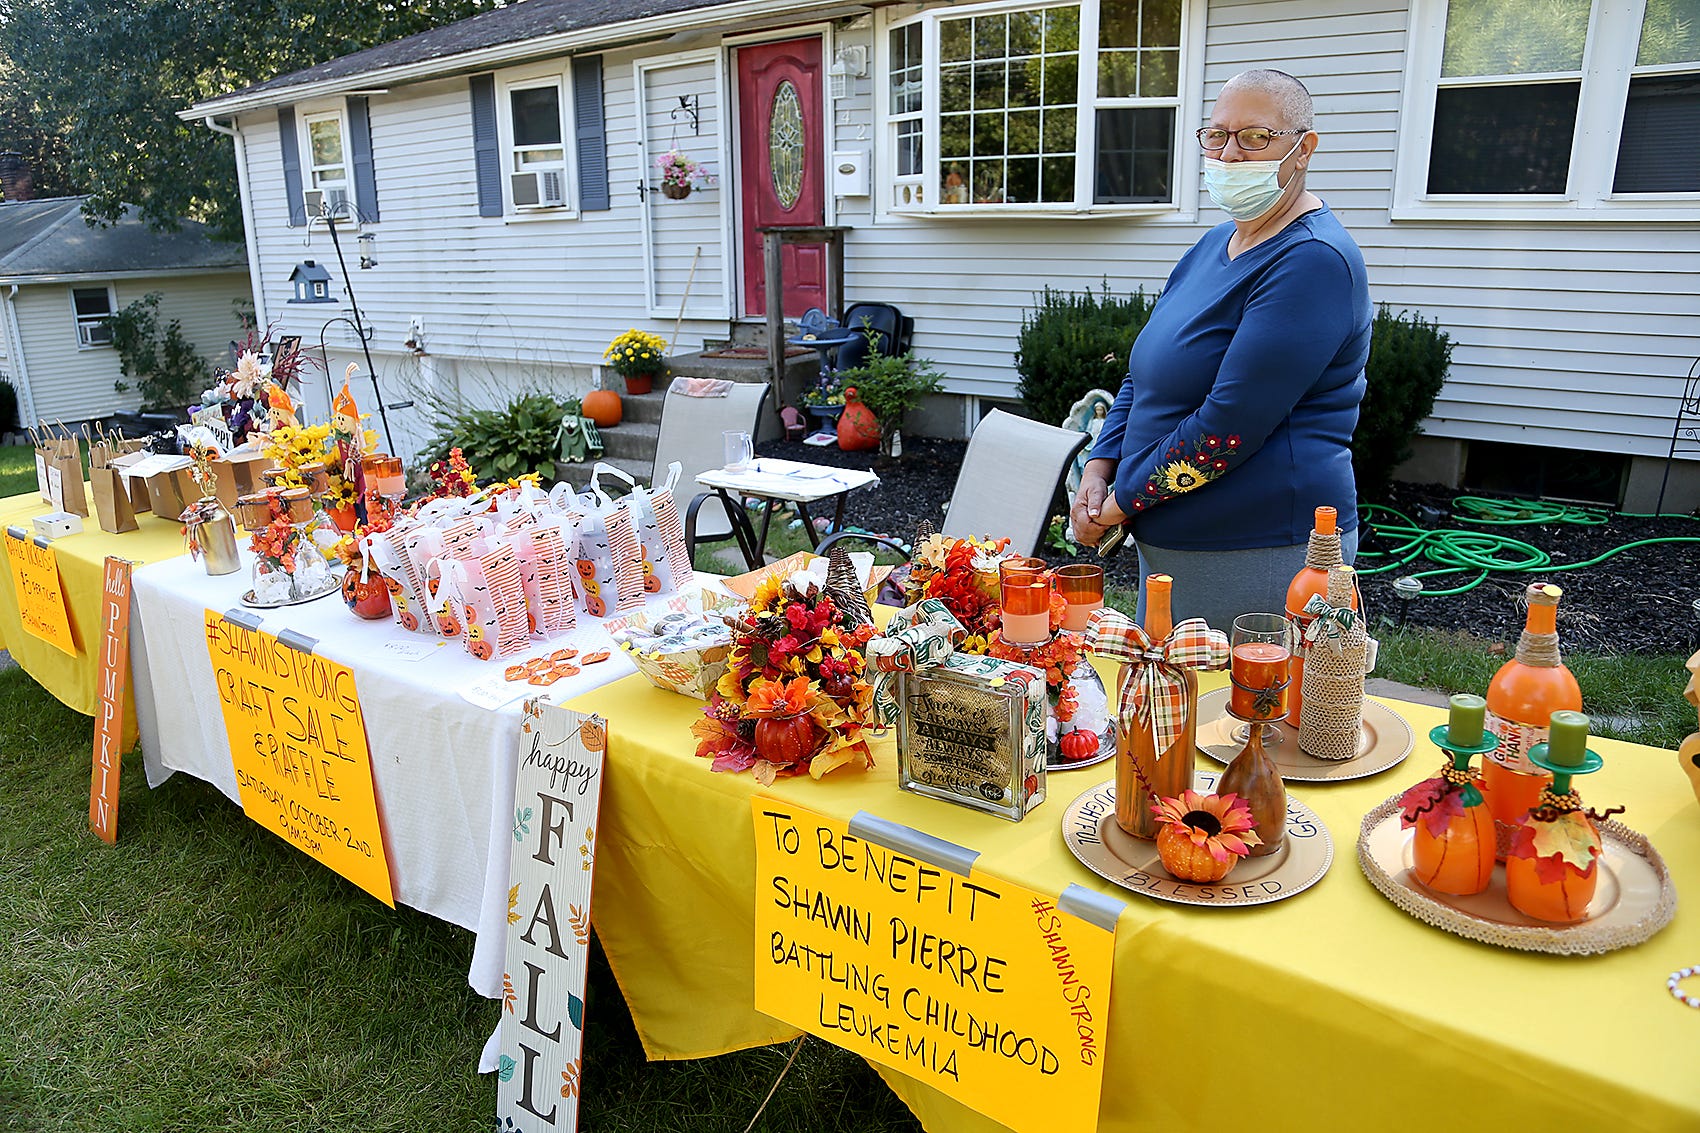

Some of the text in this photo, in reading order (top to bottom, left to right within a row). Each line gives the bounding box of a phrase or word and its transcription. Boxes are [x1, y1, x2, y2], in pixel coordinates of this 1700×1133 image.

[105, 563, 126, 598] hello
[206, 619, 360, 726] #SHAWNSTRONG
[96, 601, 120, 833] PUMPKIN
[217, 668, 356, 763] CRAFT SALE
[908, 693, 987, 724] There is
[920, 724, 988, 750] ALWAYS
[926, 713, 981, 733] ALWAYS
[267, 733, 341, 802] RAFFLE
[522, 731, 598, 795] happy
[925, 738, 984, 762] ALWAYS
[1494, 733, 1507, 762] GIVE
[237, 769, 288, 815] SATURDAY
[289, 800, 342, 842] OCTOBER
[763, 810, 1001, 922] TO BENEFIT
[1123, 872, 1283, 900] BLESSED
[515, 792, 575, 1126] FALL
[772, 876, 1008, 994] SHAWN PIERRE
[771, 931, 1060, 1076] BATTLING CHILDHOOD
[819, 992, 961, 1083] LEUKEMIA
